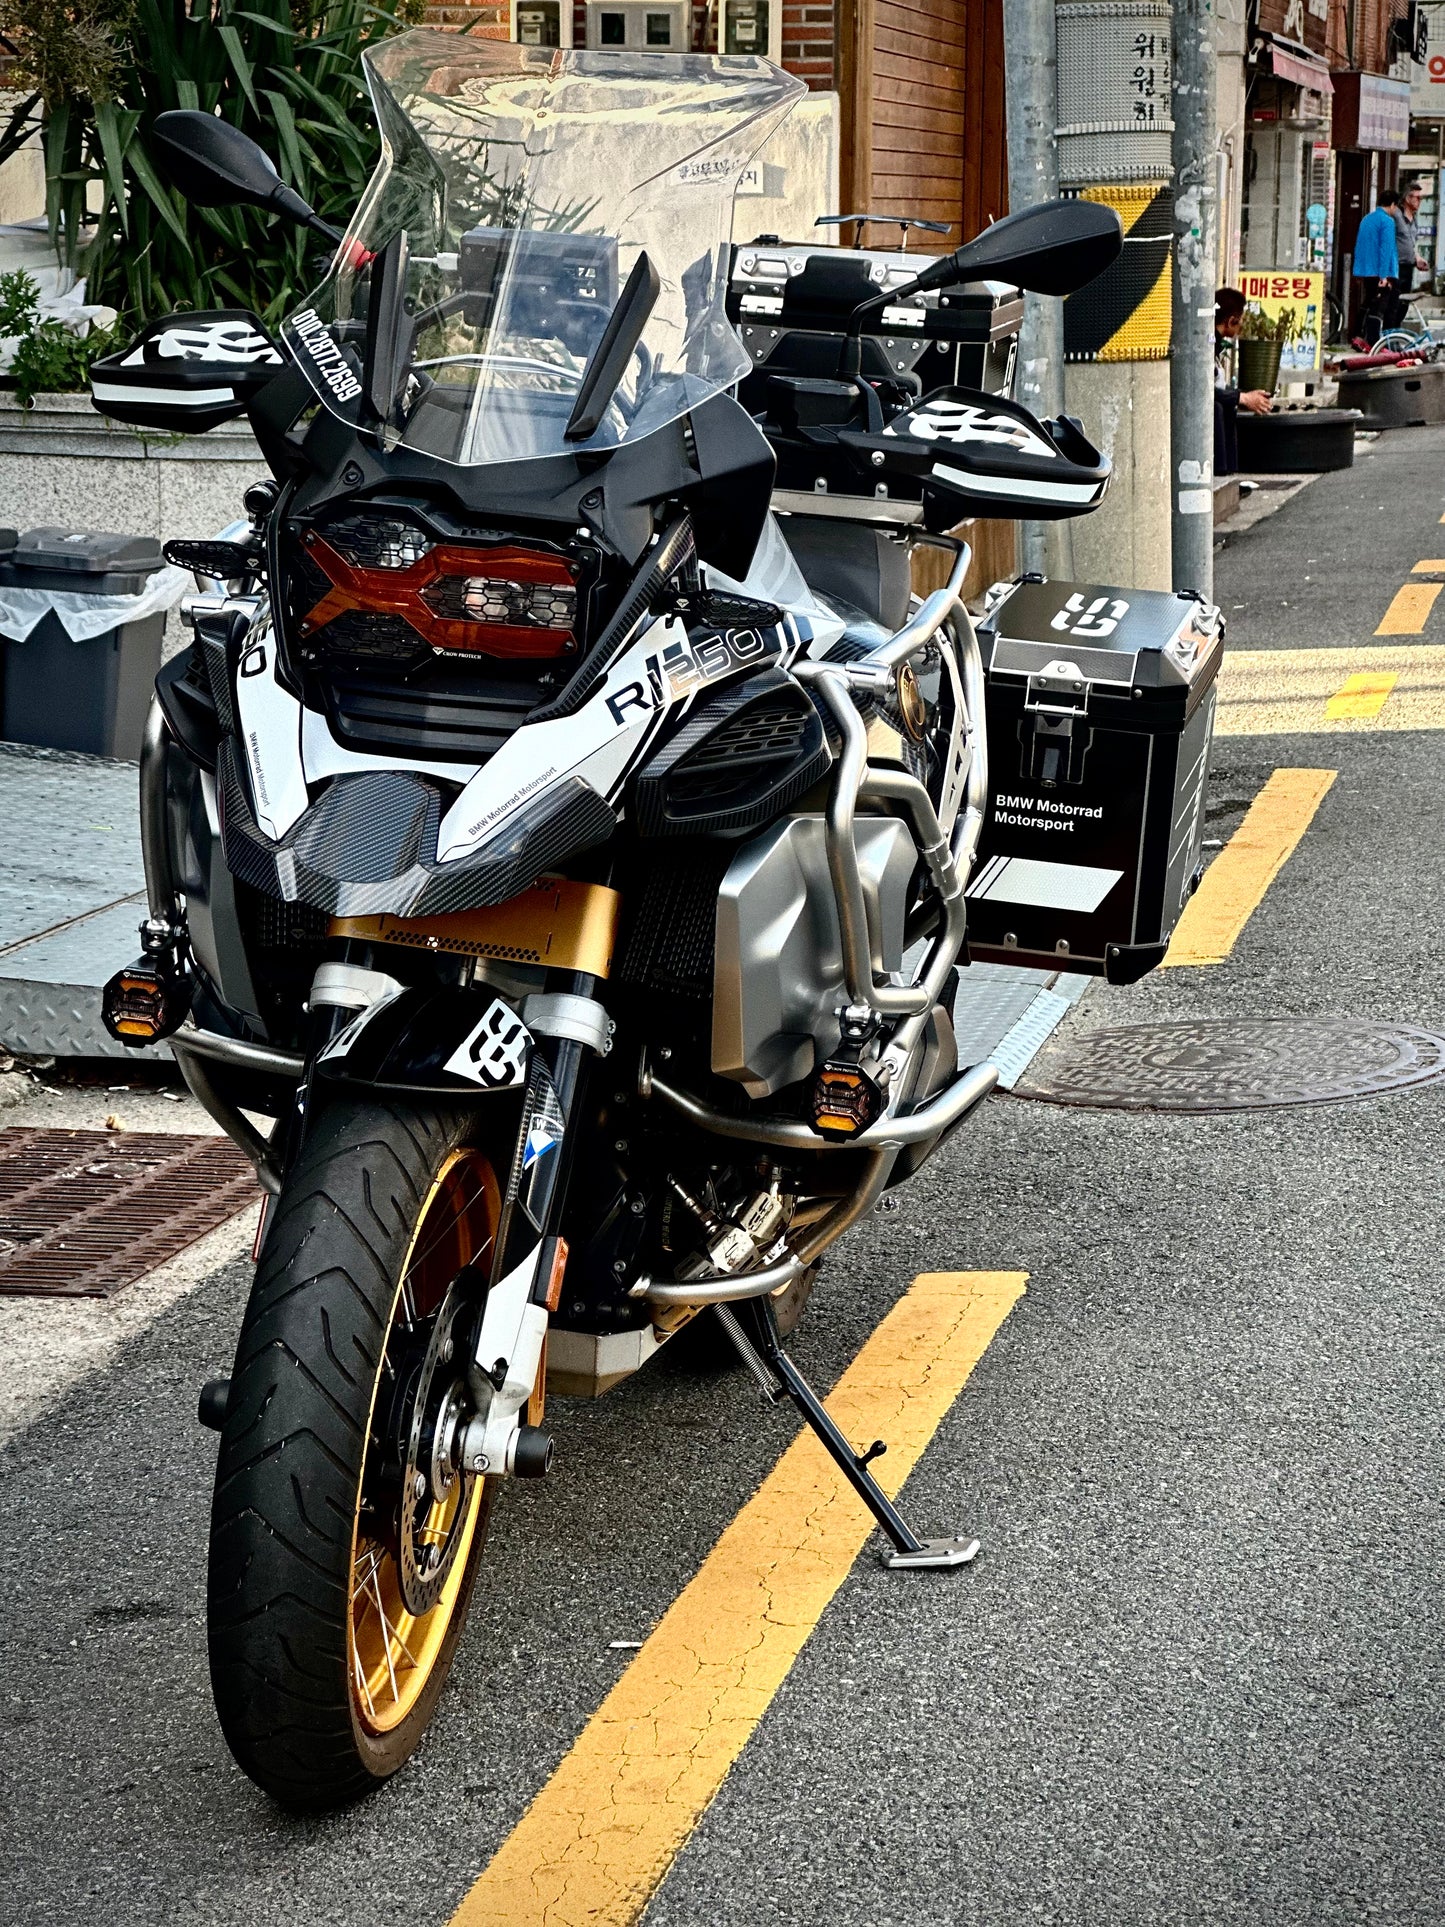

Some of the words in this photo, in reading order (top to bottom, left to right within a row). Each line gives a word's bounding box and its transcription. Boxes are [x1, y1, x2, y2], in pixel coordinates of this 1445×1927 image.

[292, 309, 362, 402] 010.2877.2699
[249, 731, 257, 748] BMW
[252, 748, 263, 774] Motorrad
[258, 772, 270, 807] Motorsport
[468, 818, 489, 836] BMW
[487, 793, 520, 822] Motorrad
[518, 766, 557, 796] Motorsport
[996, 794, 1034, 810] BMW
[1036, 799, 1103, 818] Motorrad
[994, 811, 1075, 831] Motorsport
